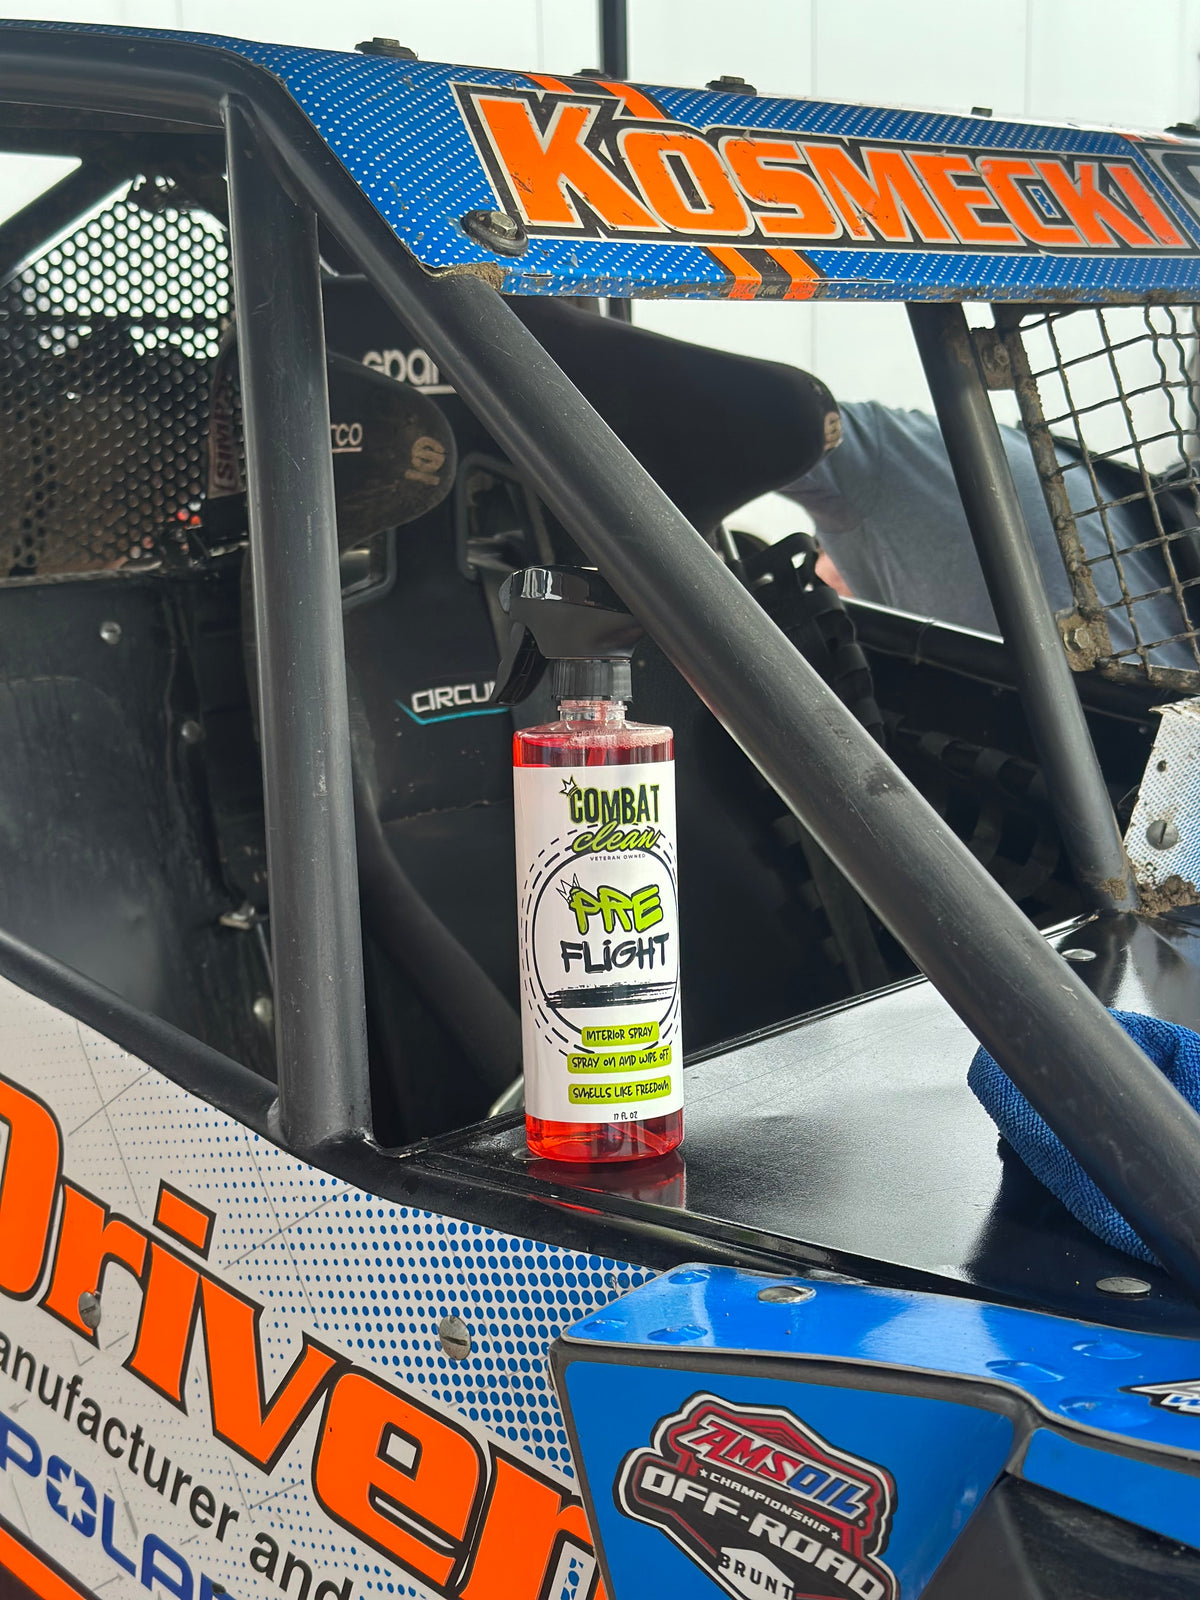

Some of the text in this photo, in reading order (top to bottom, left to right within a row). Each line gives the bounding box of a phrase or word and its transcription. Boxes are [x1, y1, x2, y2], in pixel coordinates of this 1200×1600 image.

[473, 94, 1190, 248] KOSMECKI
[569, 783, 660, 825] COMBAT
[571, 821, 663, 854] clean
[623, 853, 646, 861] OWNED
[568, 884, 664, 936] PRE
[586, 1025, 654, 1042] INTERIOR SPRAY
[571, 1047, 670, 1069] SPRAY ON AND WIPE OFF
[572, 1079, 670, 1100] SMELLS LIKE FREEDOM
[679, 1415, 869, 1518] AMSOIL
[709, 1472, 831, 1534] CHAMPIONSHIP
[640, 1465, 886, 1600] OFF-ROAD
[719, 1553, 794, 1600] BRUNT
